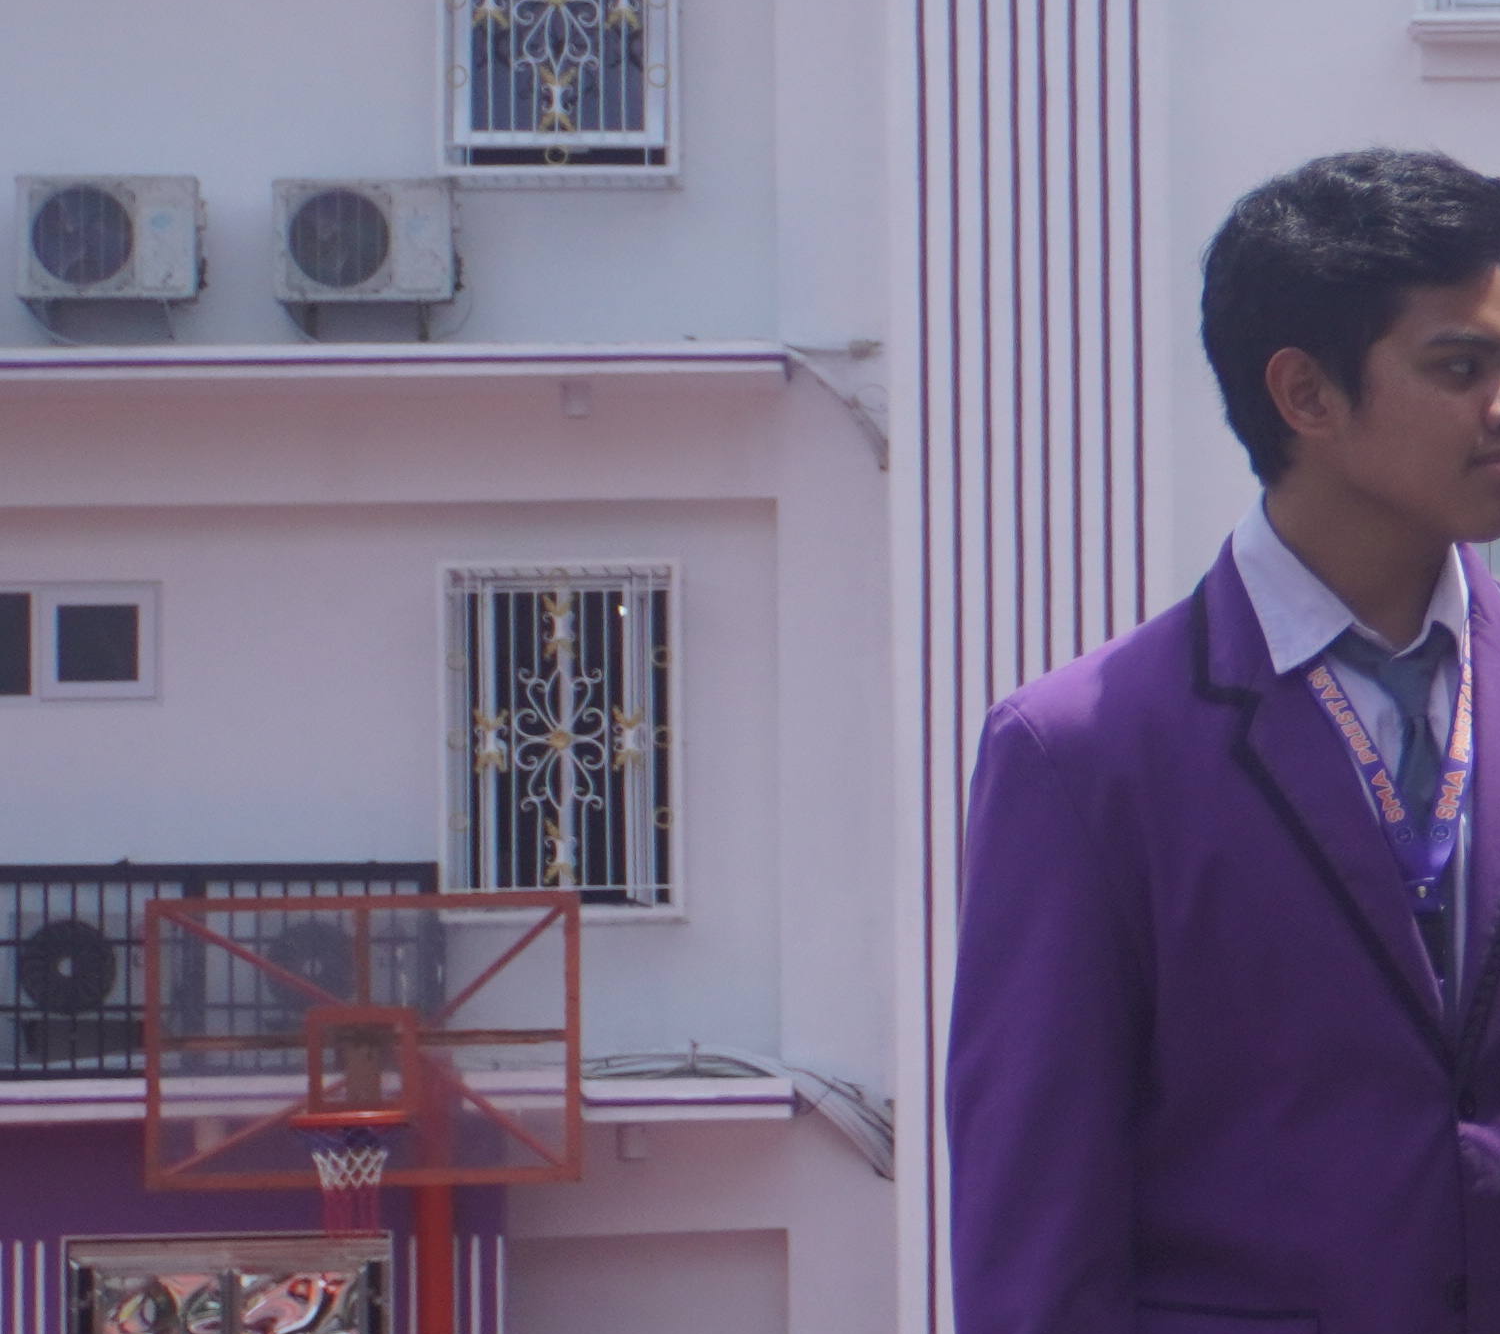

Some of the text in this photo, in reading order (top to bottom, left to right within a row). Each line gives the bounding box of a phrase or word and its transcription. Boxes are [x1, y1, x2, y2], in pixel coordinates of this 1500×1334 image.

[1308, 666, 1405, 823] SMA PRESTASI
[1435, 770, 1467, 820] SMA
